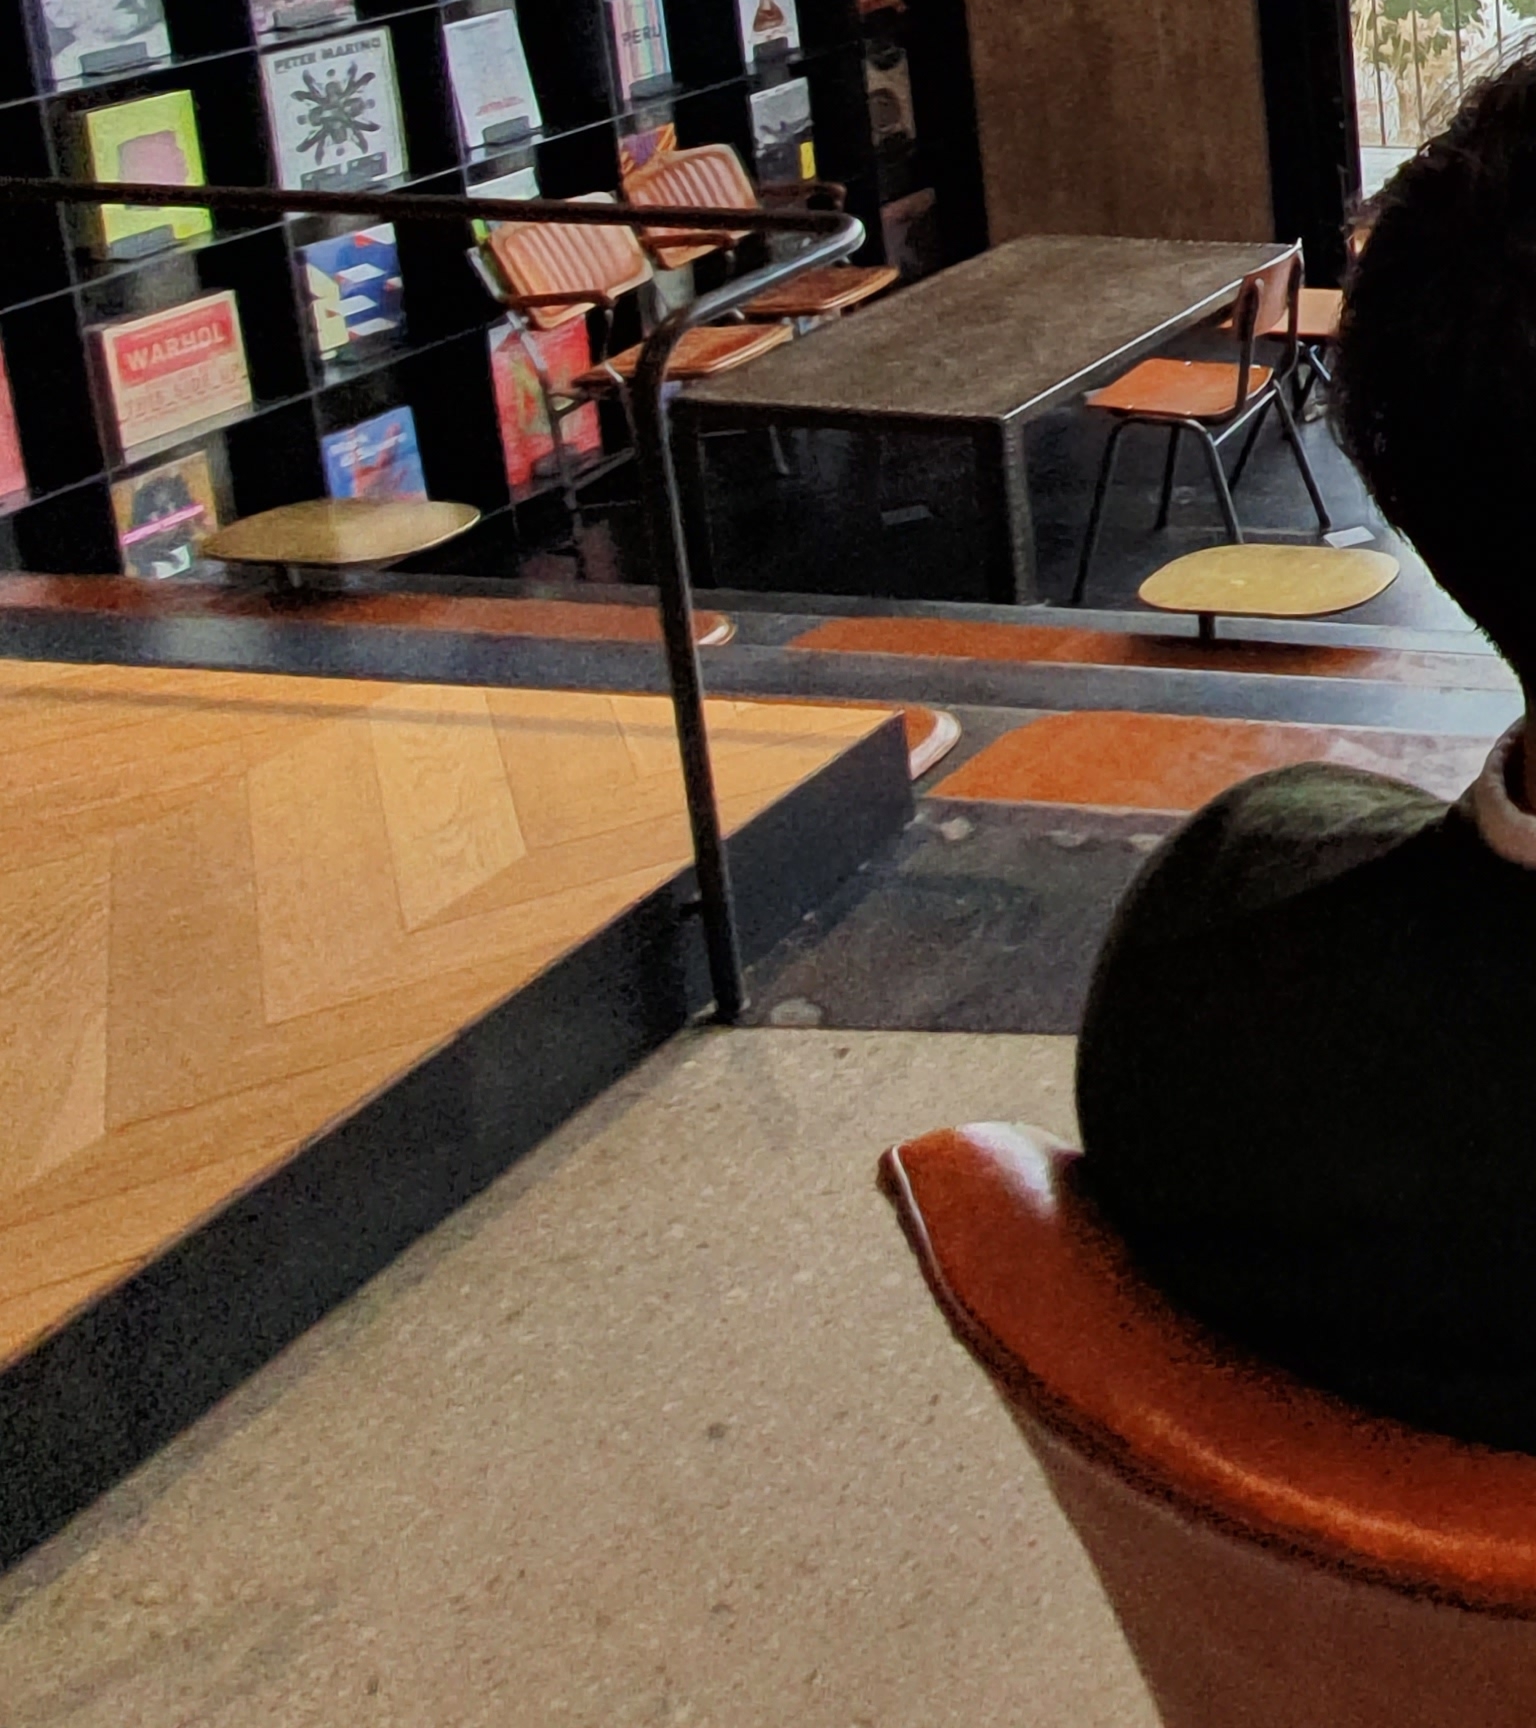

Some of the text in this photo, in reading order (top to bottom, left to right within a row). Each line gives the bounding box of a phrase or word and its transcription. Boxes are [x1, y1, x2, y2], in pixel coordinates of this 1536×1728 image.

[621, 25, 662, 47] PERU
[274, 37, 382, 74] PETER MARINO
[123, 322, 226, 373] WARHOL
